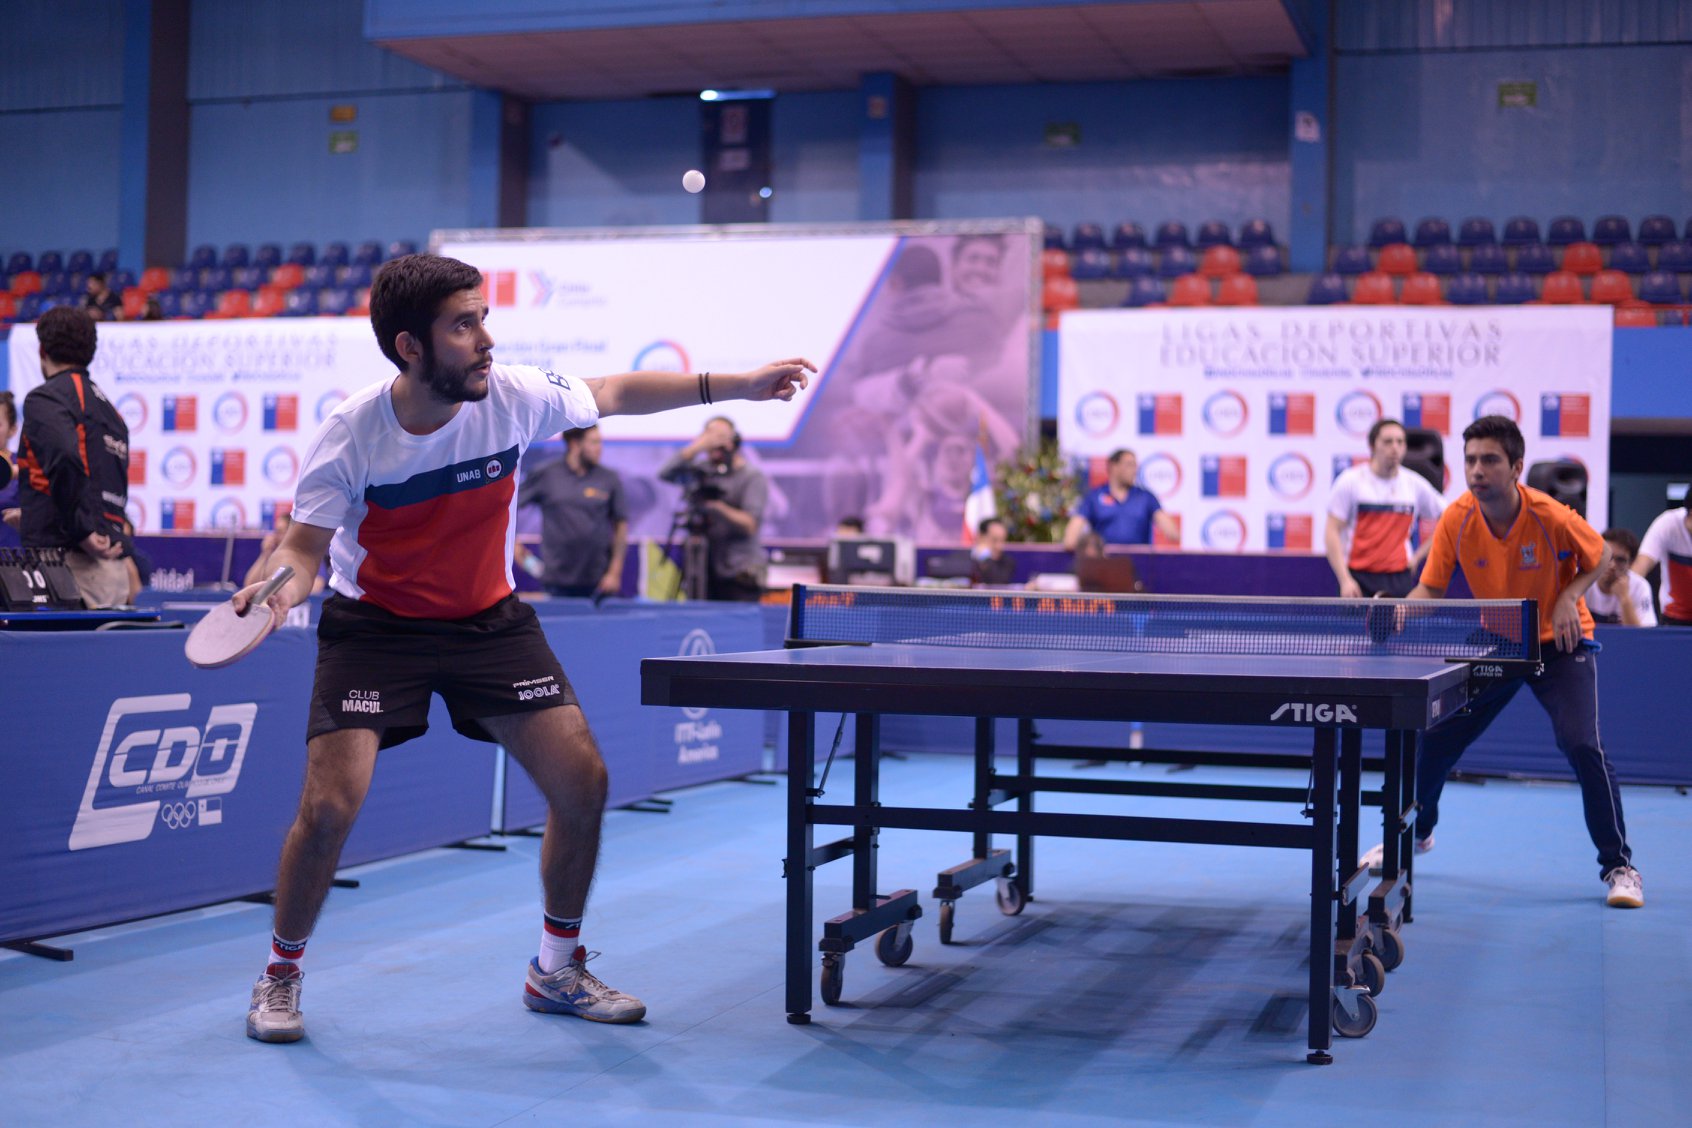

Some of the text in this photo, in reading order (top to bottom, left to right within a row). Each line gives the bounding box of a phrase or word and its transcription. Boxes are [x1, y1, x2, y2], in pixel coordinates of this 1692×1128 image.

[1162, 318, 1502, 343] LIGAS DEPORTIVAS
[1351, 341, 1501, 367] SUPERIOR
[456, 469, 481, 483] UNAB
[1472, 664, 1504, 673] STIGA
[348, 689, 380, 700] CLUB
[518, 683, 561, 701] JOOLA
[341, 699, 384, 714] MACUL
[1270, 702, 1358, 723] STIGA
